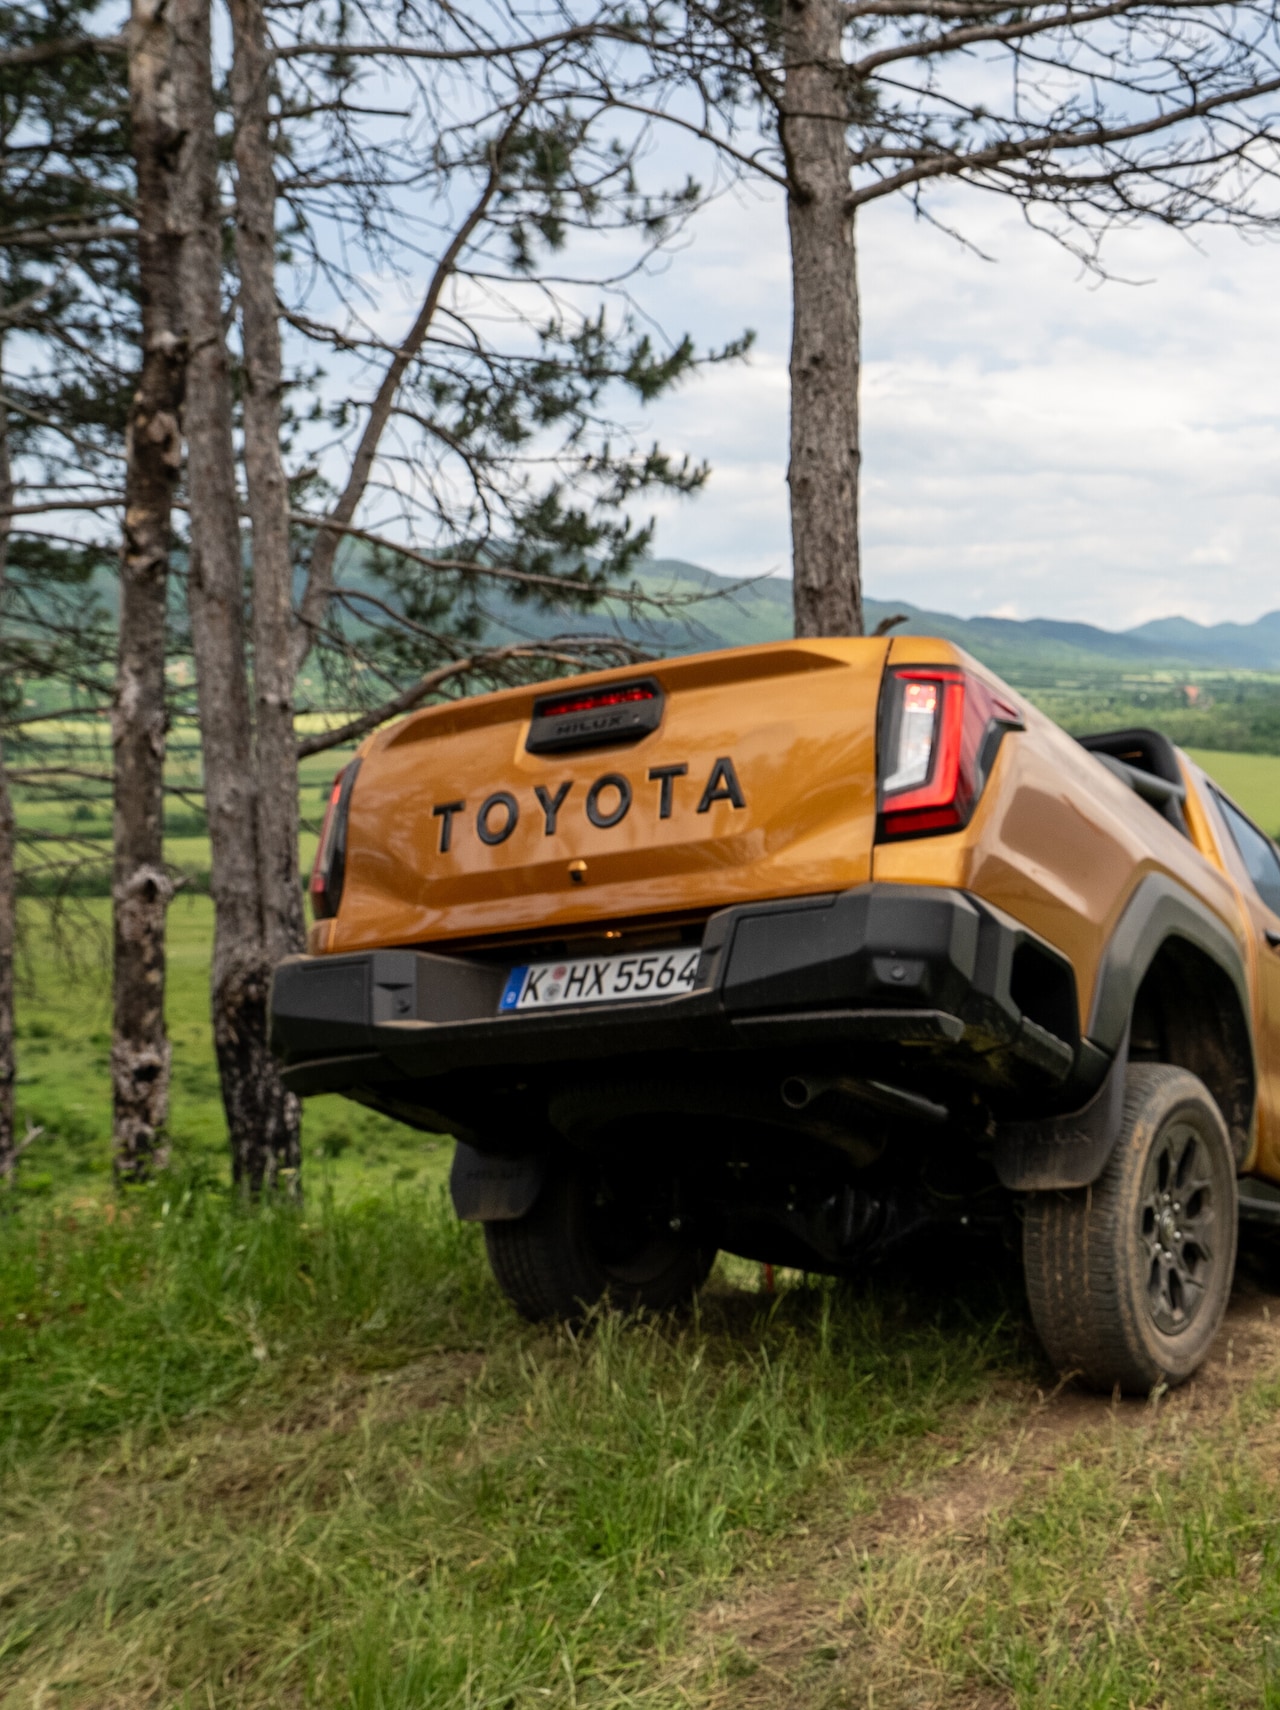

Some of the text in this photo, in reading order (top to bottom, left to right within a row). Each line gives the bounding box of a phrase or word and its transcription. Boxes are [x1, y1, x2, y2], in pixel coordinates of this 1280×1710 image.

[556, 714, 623, 735] HILUX
[433, 756, 746, 853] TOYOTA
[522, 953, 698, 1002] K HX 5564
